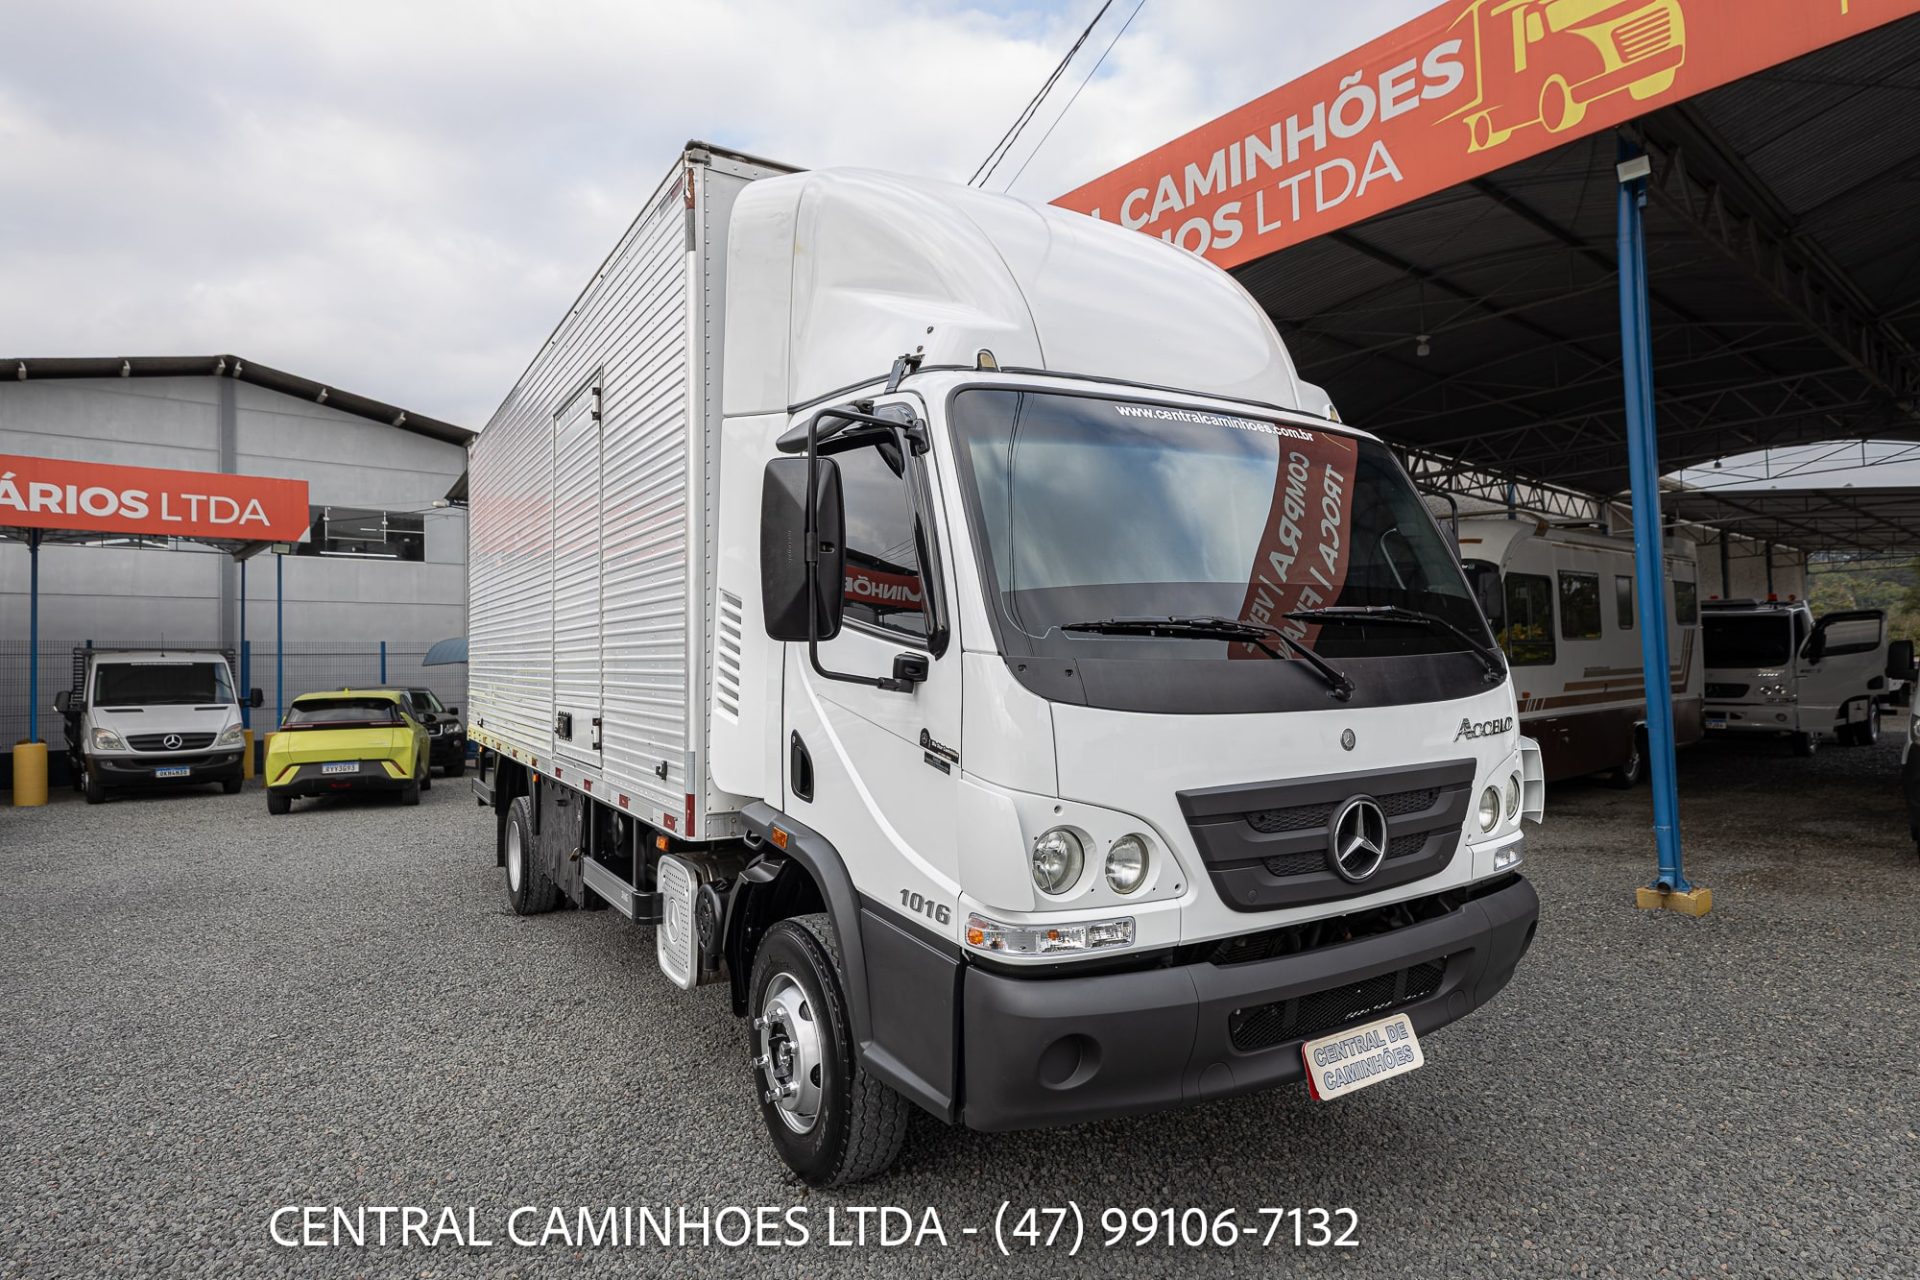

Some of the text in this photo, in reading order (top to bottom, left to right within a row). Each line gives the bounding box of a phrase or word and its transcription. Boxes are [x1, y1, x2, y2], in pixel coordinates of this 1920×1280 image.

[1120, 39, 1465, 232] CAMINHÕES
[1256, 140, 1403, 235] LTDA
[1115, 404, 1314, 442] www.centralcaminhoes.com.br
[161, 492, 270, 526] LTDA
[900, 888, 951, 925] 1016
[1313, 1021, 1408, 1068] CENTRAL DE
[1323, 1044, 1414, 1091] CAMINHÕES
